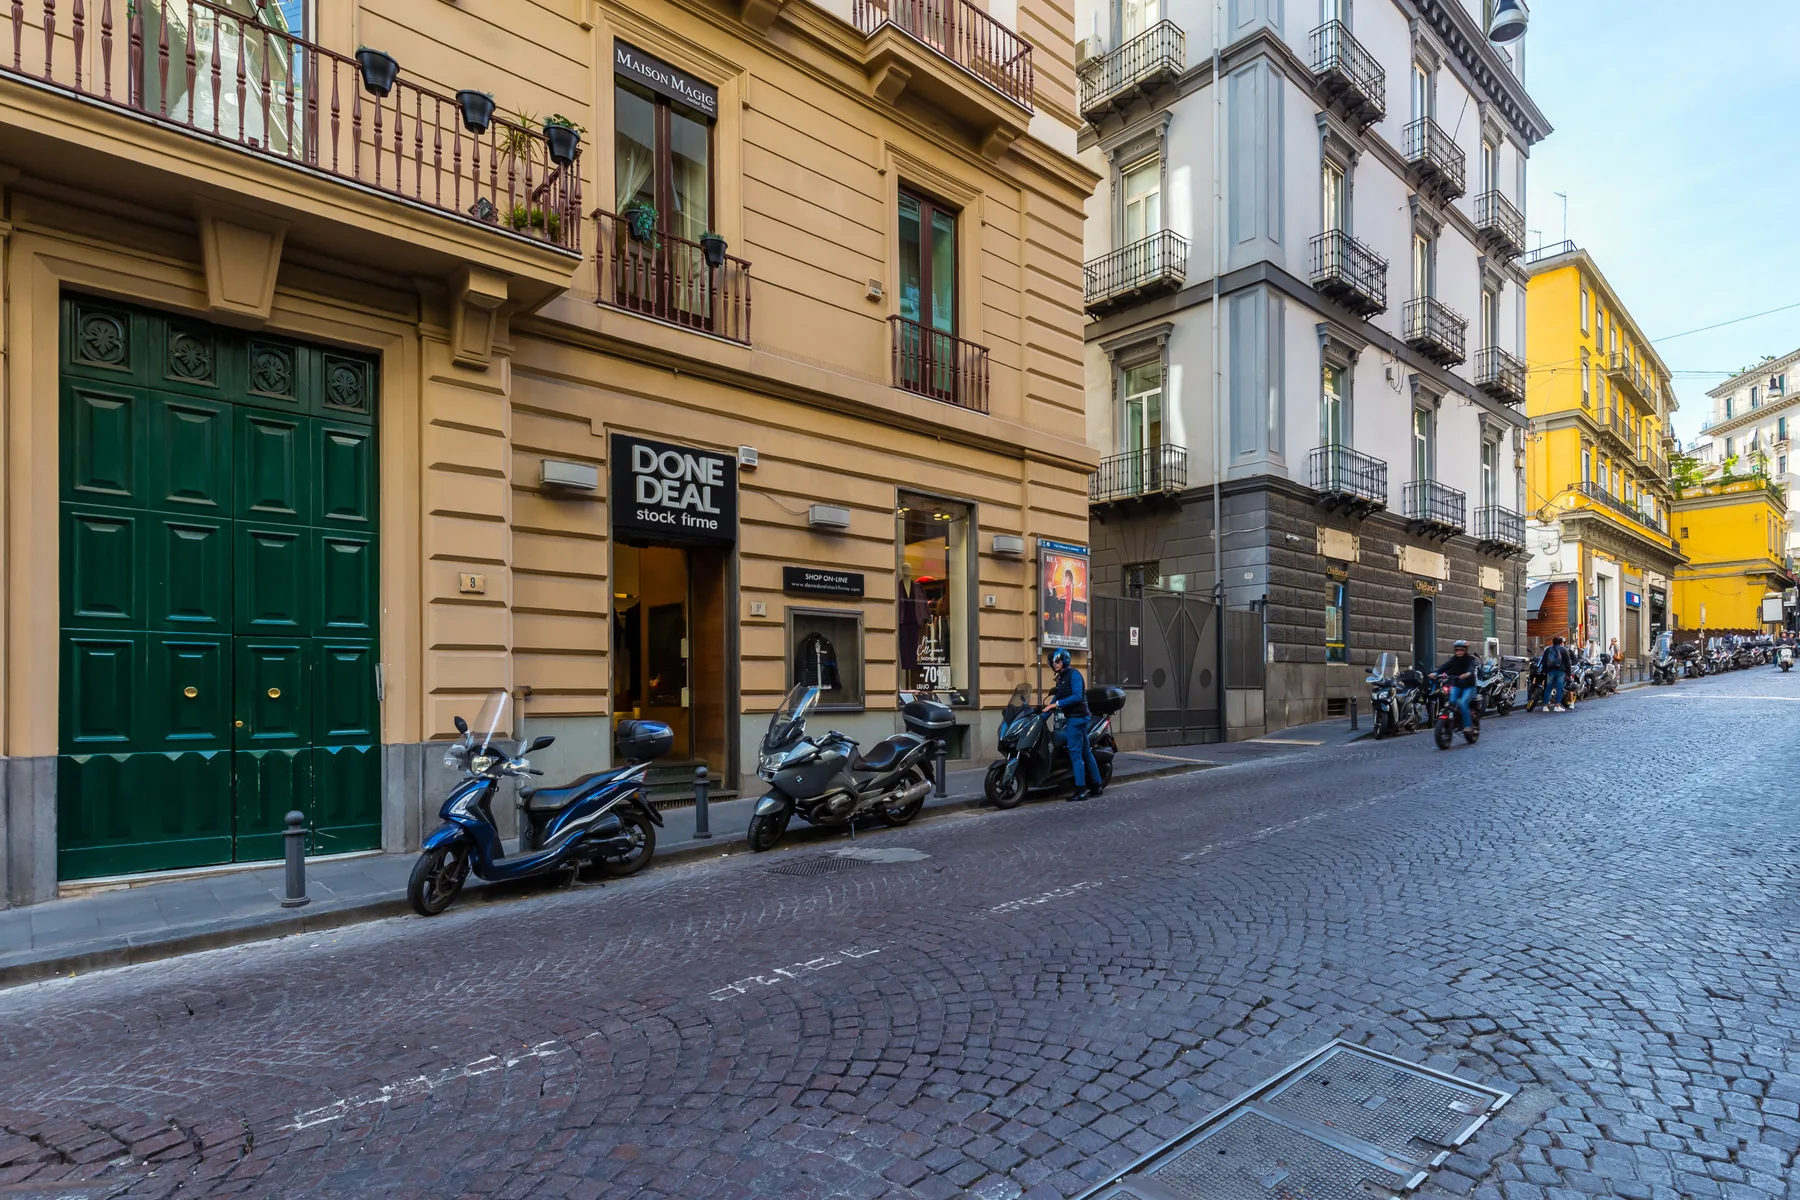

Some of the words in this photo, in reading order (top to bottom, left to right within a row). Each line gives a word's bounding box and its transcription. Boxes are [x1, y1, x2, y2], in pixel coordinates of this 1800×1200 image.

[616, 48, 668, 86] MAISON
[632, 444, 724, 487] DONE
[636, 475, 721, 515] DEAL
[636, 508, 676, 525] stock
[681, 511, 718, 530] firme
[470, 577, 476, 589] 9
[805, 573, 822, 581] SHOP
[919, 666, 947, 683] -70%
